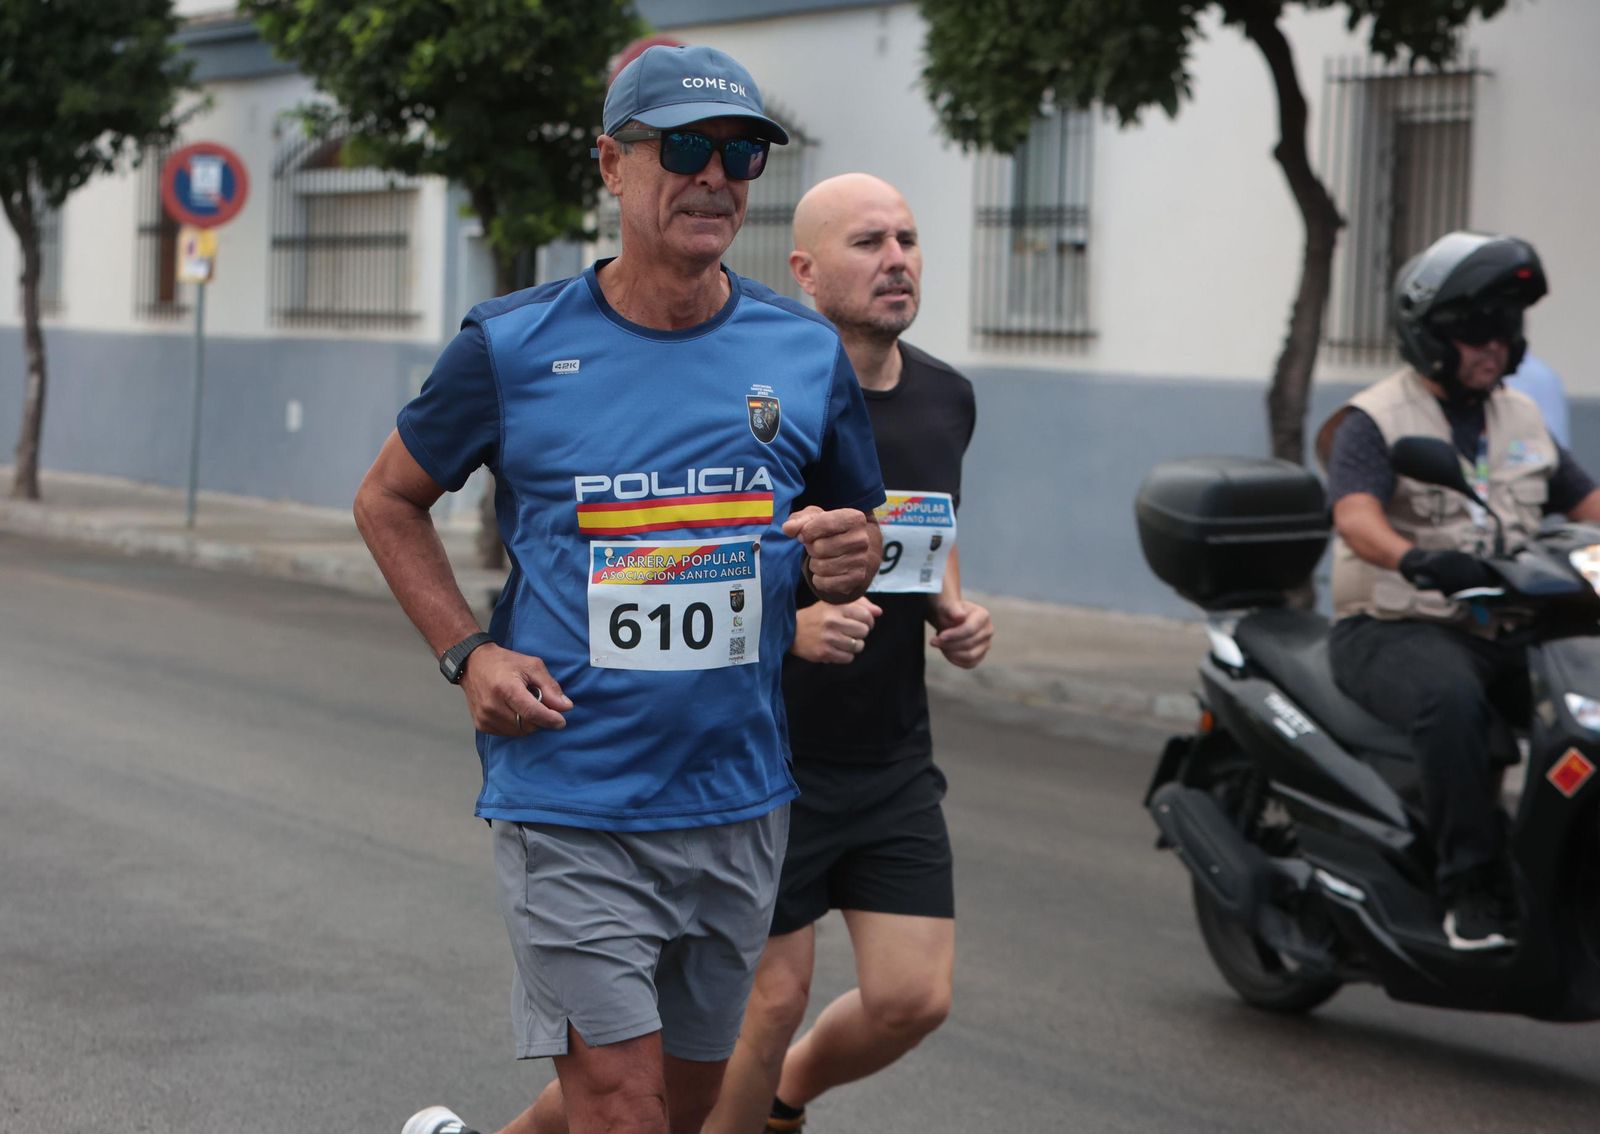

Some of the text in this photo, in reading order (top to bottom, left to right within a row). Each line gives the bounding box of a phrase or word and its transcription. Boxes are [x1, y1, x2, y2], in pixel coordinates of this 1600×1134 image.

[682, 77, 747, 97] COME ON
[554, 362, 577, 370] 42K
[899, 502, 945, 513] POPULAR
[605, 551, 746, 568] CARRERA POPULAR
[600, 565, 752, 581] ASOCIACION SANTO ANGEL
[609, 601, 714, 651] 610
